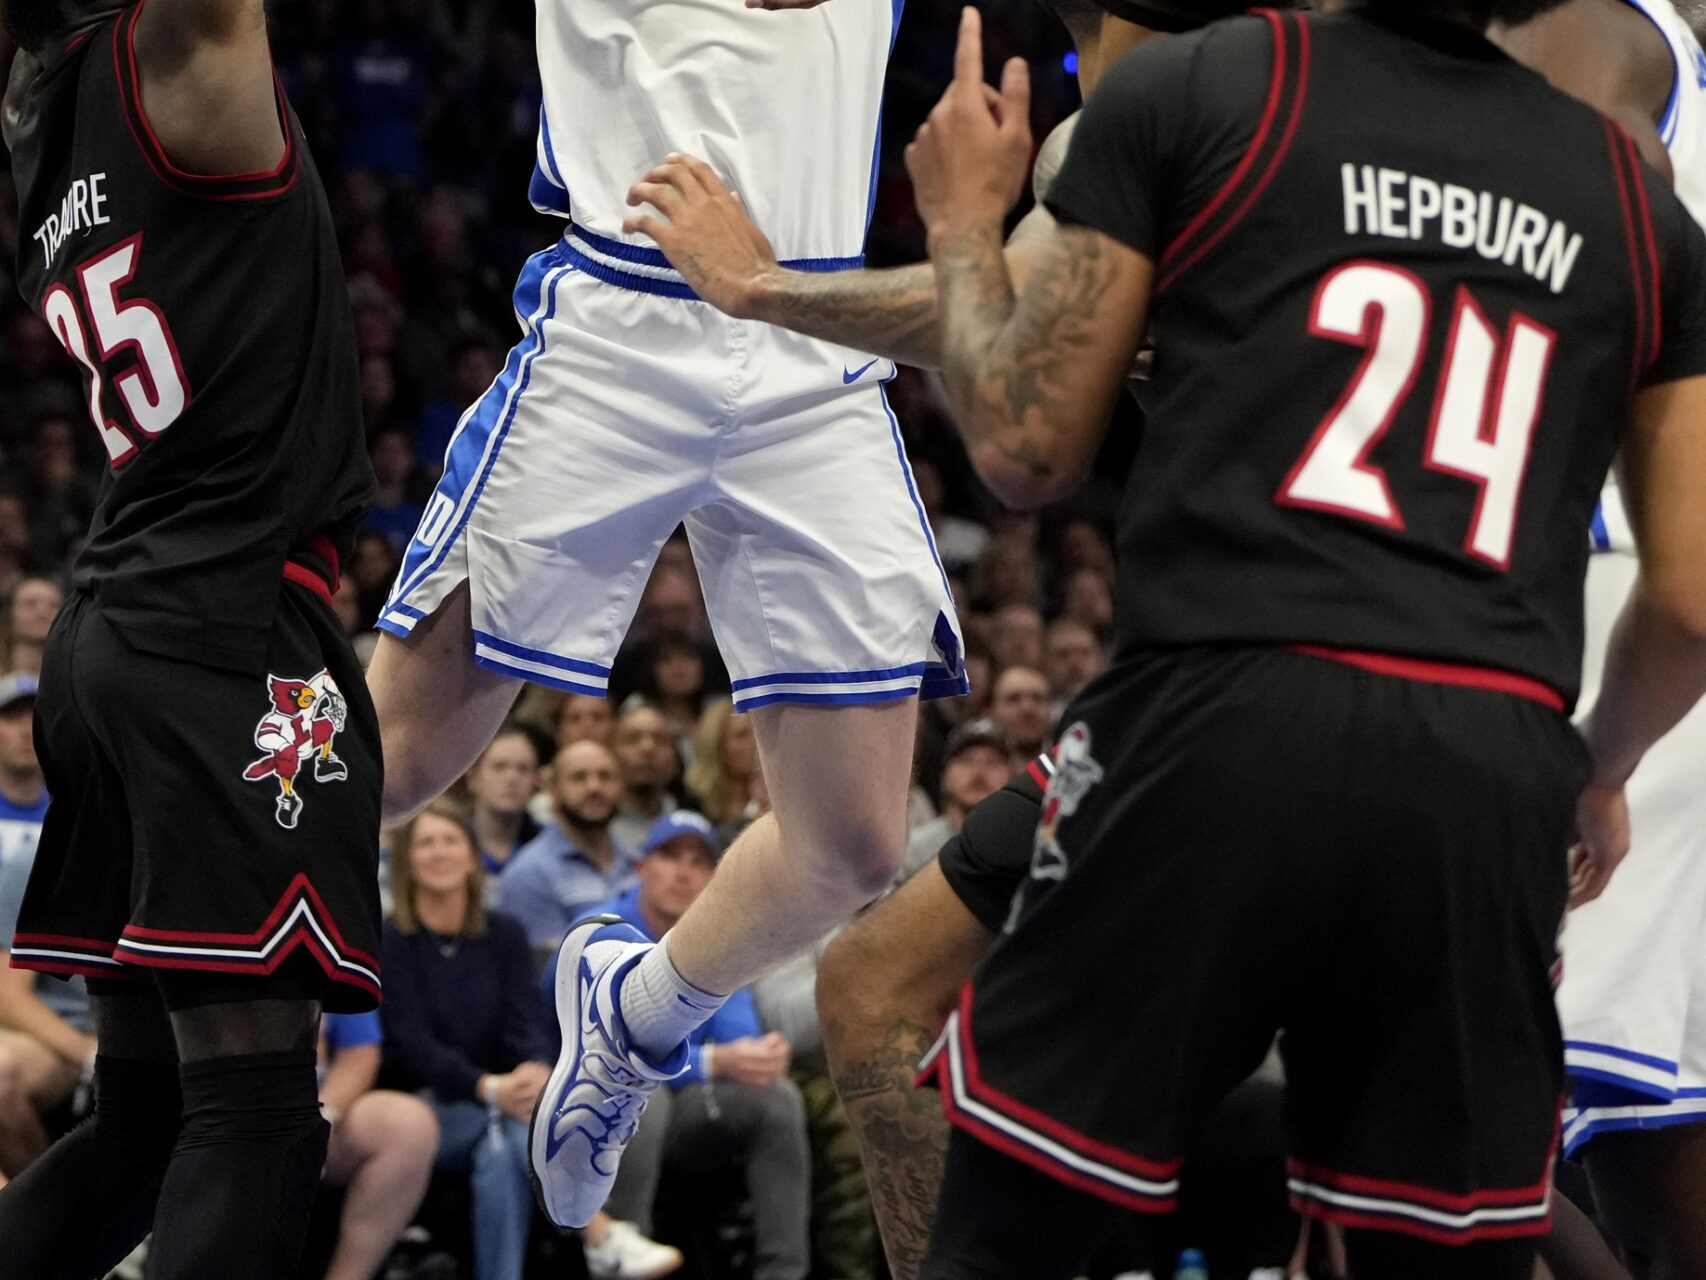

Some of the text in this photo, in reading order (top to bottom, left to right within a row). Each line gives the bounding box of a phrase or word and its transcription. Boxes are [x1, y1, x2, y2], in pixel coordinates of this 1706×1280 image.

[1341, 162, 1584, 294] HEPBURN
[42, 230, 192, 469] 25
[1273, 258, 1558, 572] 24
